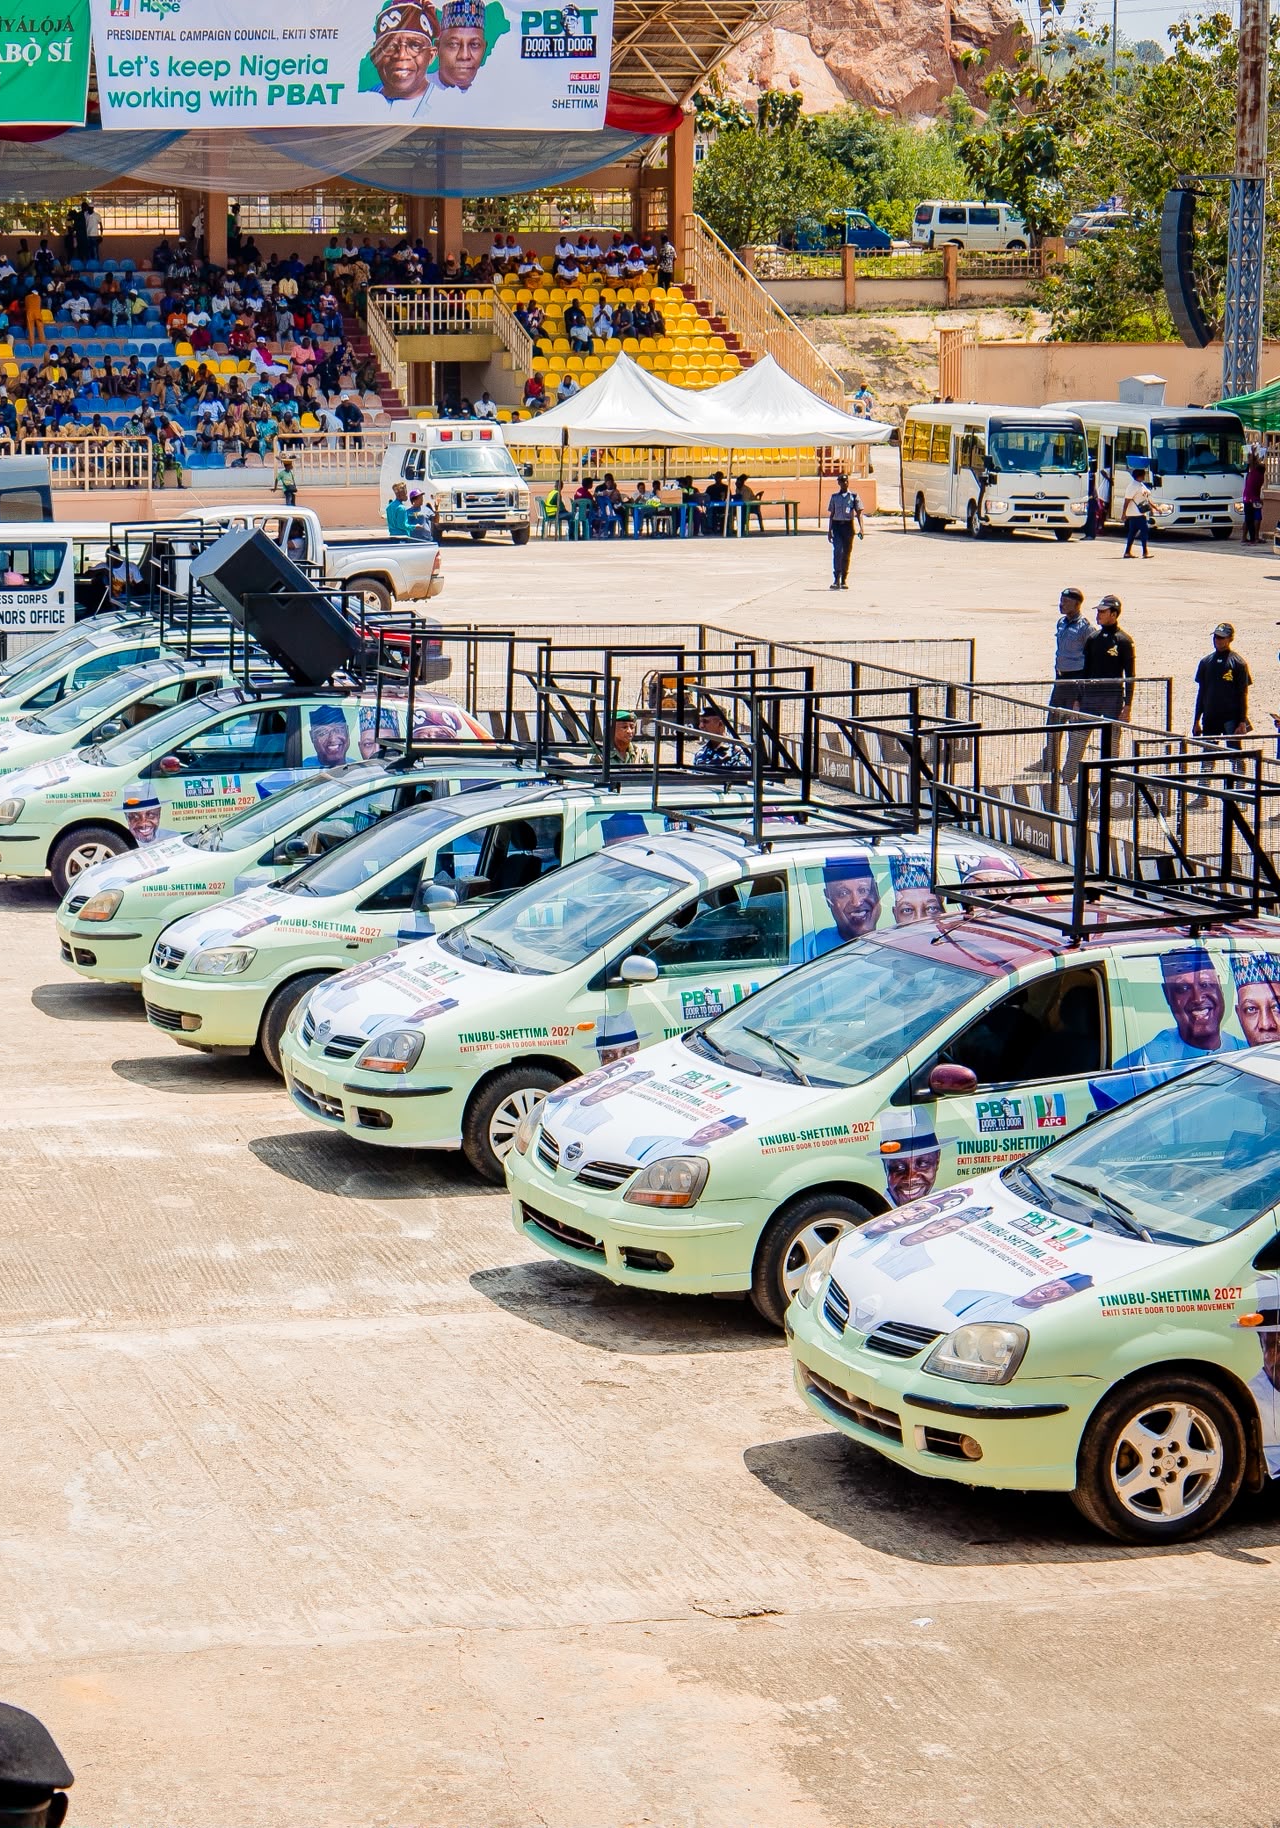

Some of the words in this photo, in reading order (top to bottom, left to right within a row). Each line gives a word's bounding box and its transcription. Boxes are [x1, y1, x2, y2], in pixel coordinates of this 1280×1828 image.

[107, 29, 176, 41] PRESIDENTIAL
[180, 30, 231, 41] CAMPAIGN
[234, 29, 279, 41] COUNCIL,
[282, 29, 306, 40] EKITI
[310, 29, 339, 39] STATE
[47, 37, 73, 62] SÍ
[526, 38, 550, 52] DOOR
[553, 38, 565, 52] TO
[568, 38, 593, 52] DOOR
[107, 55, 160, 77] Let's
[168, 56, 231, 81] keep
[240, 54, 328, 81] Nigeria
[568, 84, 600, 94] TINUBU
[107, 86, 201, 113] working
[209, 85, 257, 107] with
[267, 83, 345, 106] PBAT
[552, 99, 599, 109] SHETTIMA
[17, 594, 47, 605] CORPS
[30, 610, 65, 624] OFFICE
[46, 791, 101, 799] TINUBU-SHETTIMA
[102, 790, 117, 798] 2027
[172, 798, 236, 809] TINUBU-SHETTIMA
[142, 883, 207, 892] TINUBU-SHETTIMA
[208, 882, 226, 890] 2027
[359, 926, 381, 937] 2027
[685, 1007, 699, 1016] DOOR
[700, 1006, 707, 1014] TO
[458, 1027, 549, 1044] TINUBU-SHETTIMA
[551, 1026, 575, 1037] 2027
[981, 1119, 996, 1128] DOOR
[998, 1119, 1006, 1127] TO
[1007, 1117, 1022, 1126] DOOR
[1043, 1118, 1062, 1126] APC
[759, 1125, 850, 1147] TINUBU-SHETTIMA
[852, 1121, 876, 1134] 2027
[761, 1146, 776, 1155] EKITI
[778, 1145, 795, 1153] STATE
[796, 1143, 812, 1151] DOOR
[822, 1140, 837, 1148] DOOR
[839, 1134, 870, 1145] MOVEMENT
[957, 1157, 972, 1165] EKITI
[974, 1155, 991, 1164] STATE
[1098, 1289, 1211, 1307] TINUBU-SHETTIMA
[1214, 1288, 1243, 1300] 2027
[1102, 1308, 1121, 1317] EKITI
[1122, 1307, 1143, 1316] STATE
[1145, 1306, 1164, 1315] DOOR
[1176, 1304, 1195, 1313] DOOR
[1196, 1302, 1235, 1312] MOVEMENT
